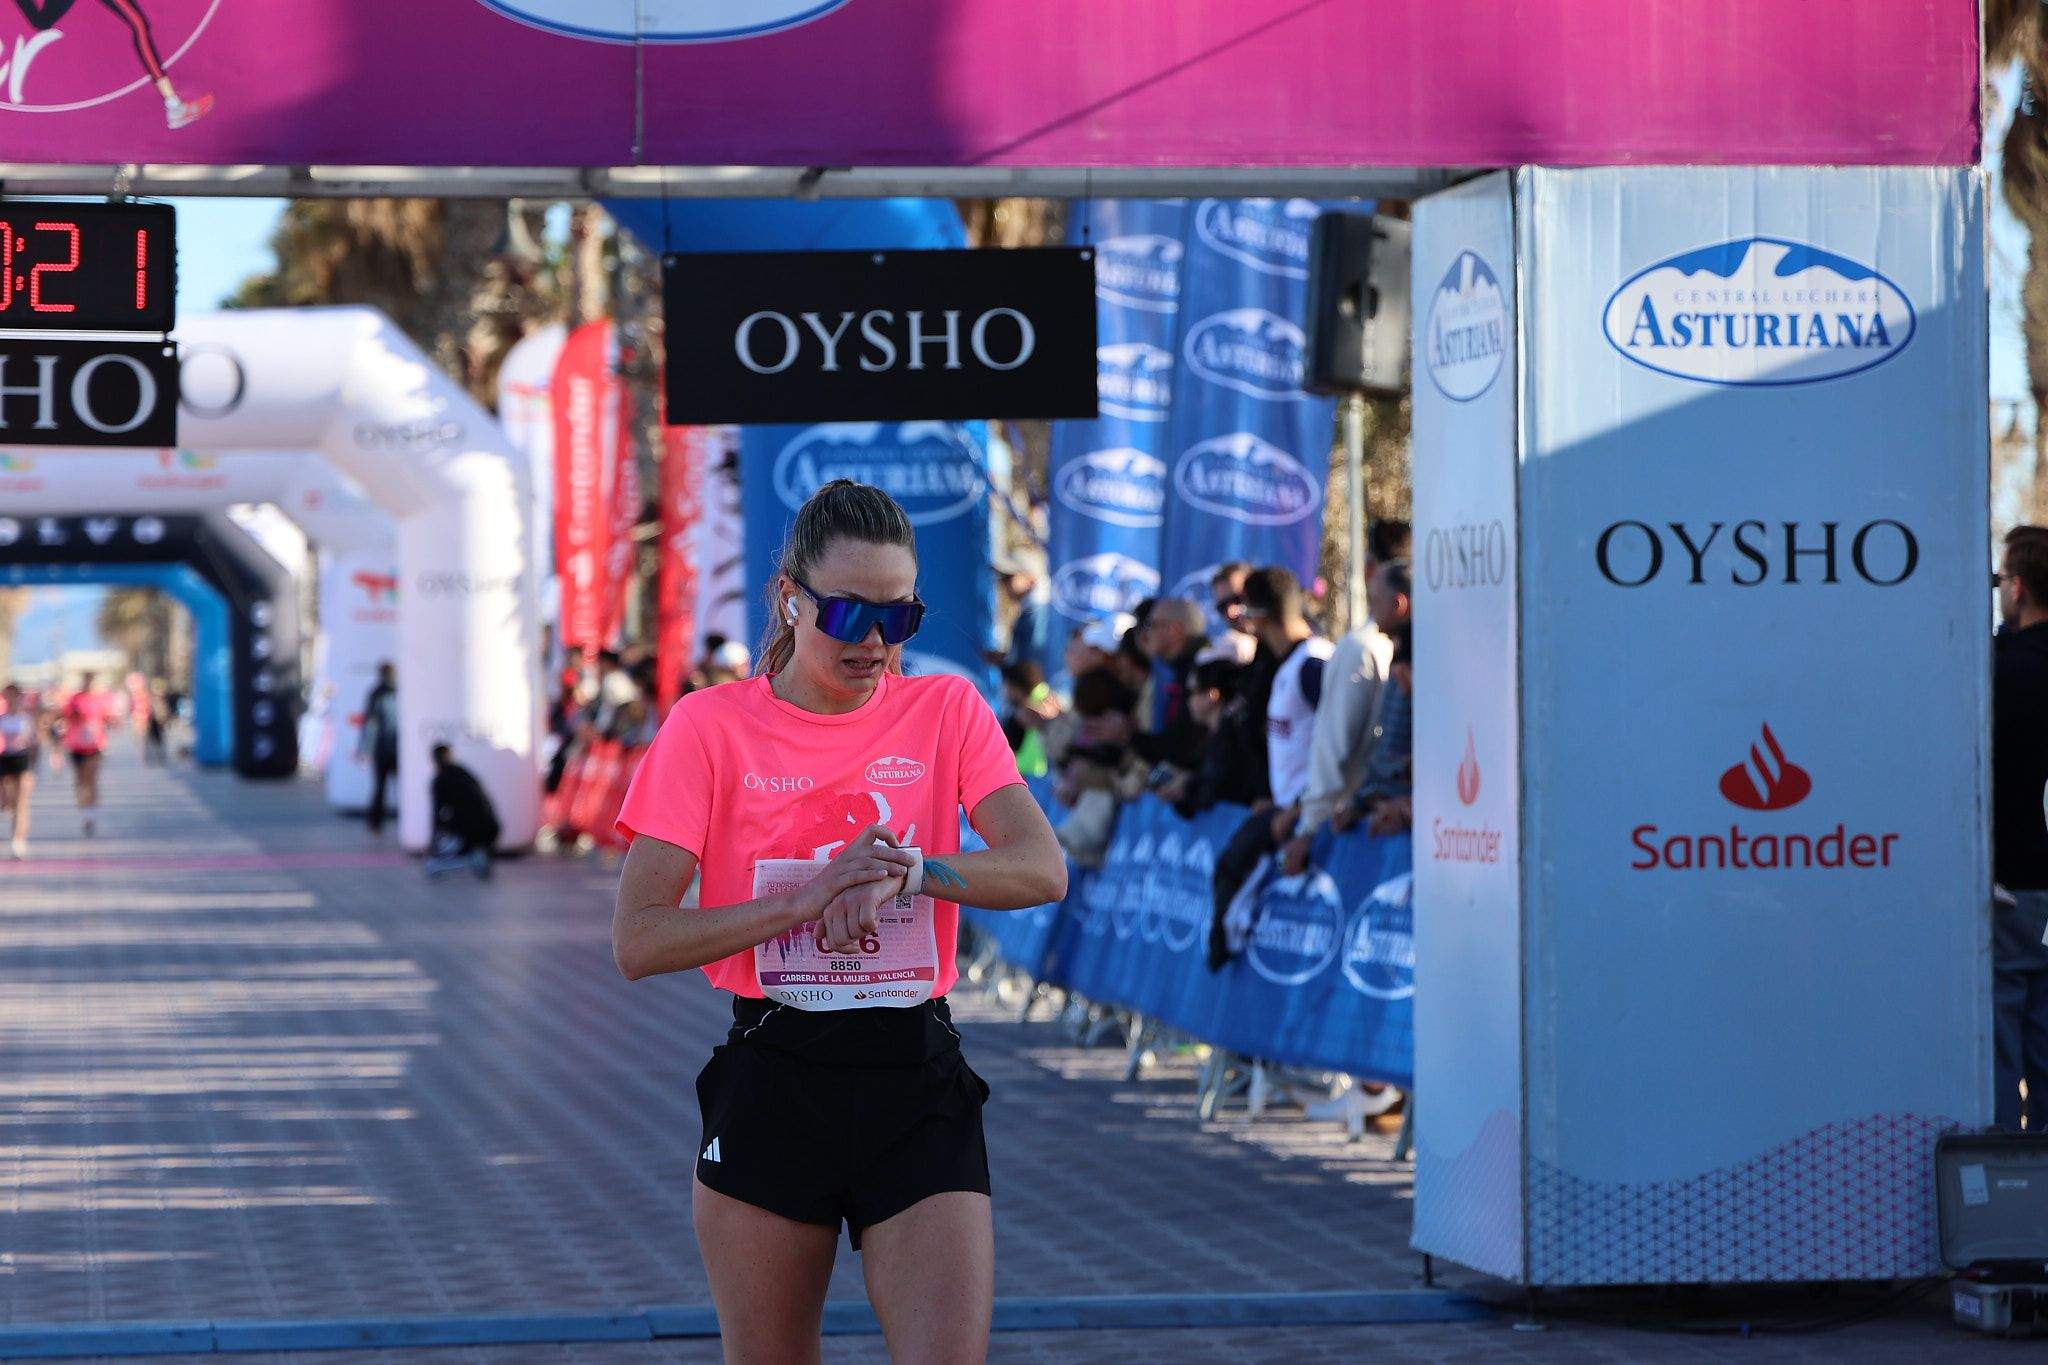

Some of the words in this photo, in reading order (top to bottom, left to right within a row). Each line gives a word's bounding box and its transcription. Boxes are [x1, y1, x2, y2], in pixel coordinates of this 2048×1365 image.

[735, 308, 1036, 374] OYSHO
[1627, 294, 1892, 348] ASTURIANA
[1425, 520, 1507, 592] OYSHO
[1595, 519, 1919, 588] OYSHO
[743, 773, 814, 792] OYSHO
[1432, 816, 1502, 864] Santander
[1631, 824, 1900, 871] Santander
[780, 974, 817, 983] CARRERA
[819, 974, 829, 983] DE
[831, 974, 841, 983] LA
[843, 974, 871, 983] MUJER
[877, 971, 916, 981] VALENCIA
[830, 960, 861, 971] 8850
[868, 988, 919, 1000] Santander
